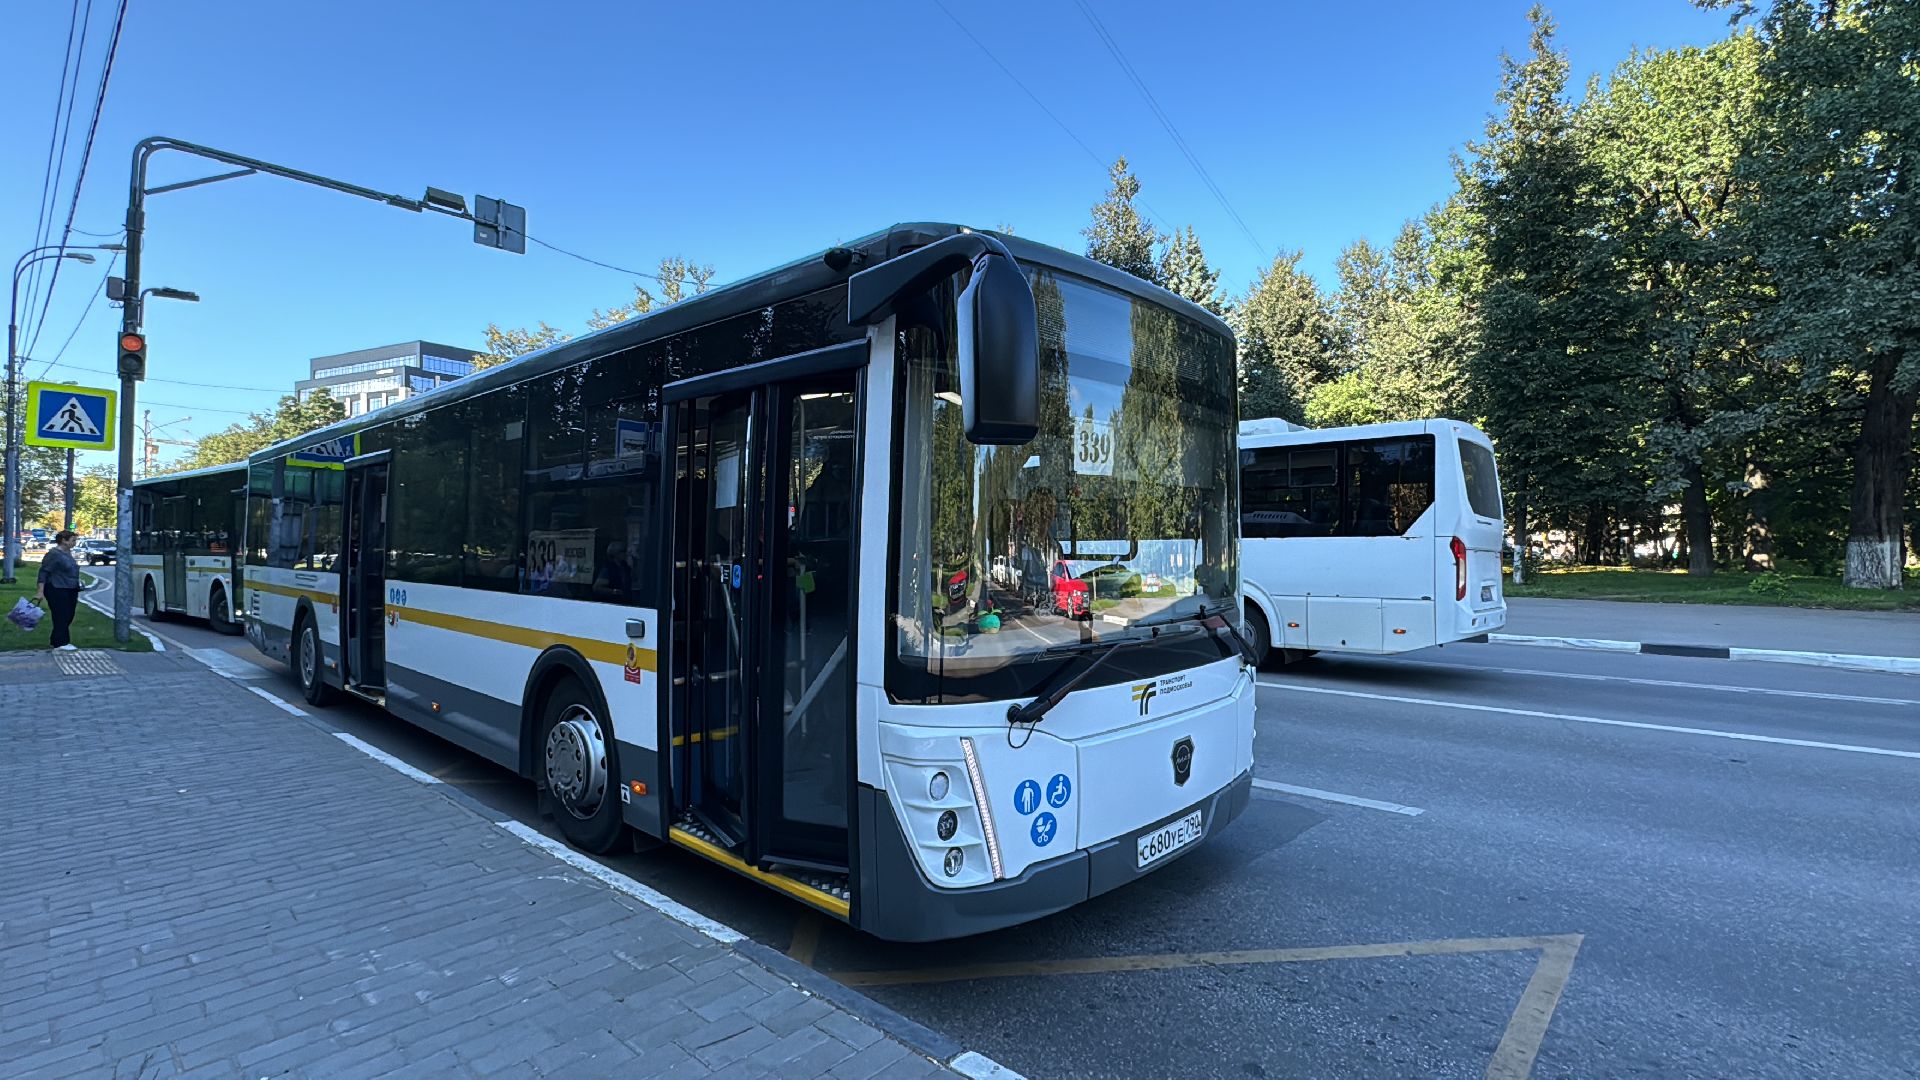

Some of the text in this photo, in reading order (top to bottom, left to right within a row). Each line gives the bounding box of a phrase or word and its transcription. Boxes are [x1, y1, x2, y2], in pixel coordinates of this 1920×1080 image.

[1079, 430, 1111, 464] 339
[1160, 674, 1186, 687] ТРАНСПОРТ
[1160, 680, 1193, 695] ПОДМОСКОВЬЯ
